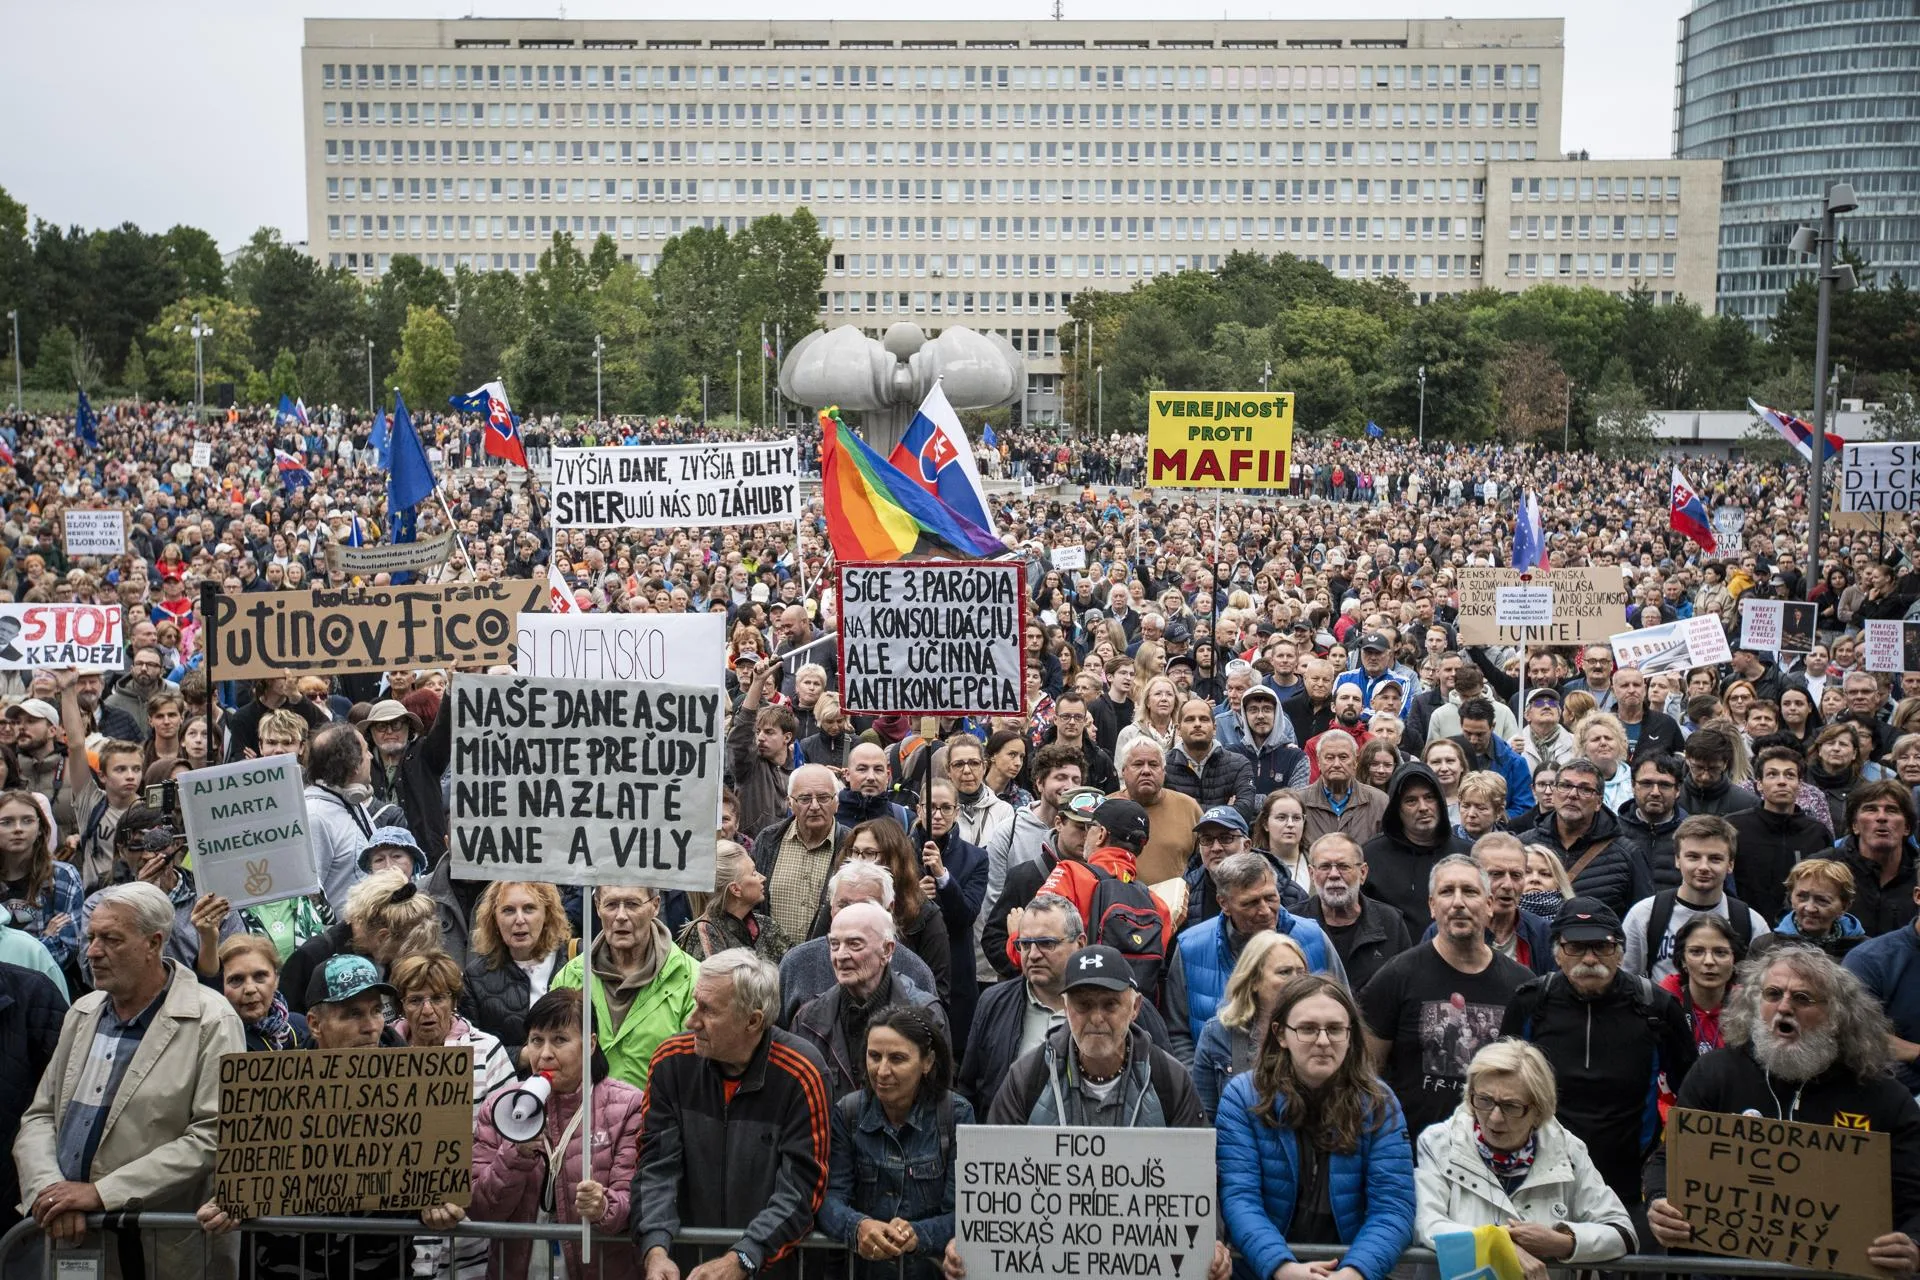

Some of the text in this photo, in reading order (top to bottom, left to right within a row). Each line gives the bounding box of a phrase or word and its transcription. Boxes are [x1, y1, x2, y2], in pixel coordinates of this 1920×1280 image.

[1156, 398, 1288, 421] VEREJNOSŤ
[1188, 426, 1252, 441] PROTI
[554, 447, 797, 485] ZVÝŠIA DANE, ZVÝŠIA DLHY,
[1152, 448, 1286, 482] MAFII
[660, 488, 691, 518] NÁS
[697, 494, 716, 516] DO
[719, 479, 795, 518] ZÁHUBY
[68, 538, 120, 546] SLOBODA!
[1535, 571, 1586, 580] SLOVENSKA
[23, 607, 121, 646] STOP
[844, 605, 1018, 647] NA KONSOLIDÁCIU,
[846, 639, 998, 676] ALE ÚČINNÁ
[458, 678, 719, 738] NAŠE DANE A SILY
[846, 676, 1019, 712] ANTIKONCEPCIA
[456, 729, 717, 779] MÍŇAJTE PRE ĽUDÍ
[194, 766, 285, 796] AJ JA SOM
[456, 780, 508, 818] NIE
[518, 778, 564, 818] NA
[210, 796, 278, 820] MARTA
[197, 820, 304, 856] ŠIMEČKOVÁ
[456, 826, 692, 871] VANE A VILY
[220, 1052, 468, 1084] OPOZICIA JE SLOVENSKO
[222, 1081, 472, 1115] DEMOKRATI, SAS A KDH.
[218, 1112, 422, 1144] MOŽNO SLOVENSKO
[1678, 1110, 1870, 1155] KOLABORANT
[216, 1140, 461, 1174] ZOBERIE DO VLADY AJ PS
[1055, 1134, 1106, 1158] FICO
[1709, 1142, 1802, 1174] FICO
[216, 1177, 246, 1204] ALE
[251, 1176, 274, 1201] TO
[280, 1174, 300, 1198] SA
[400, 1168, 472, 1196] ŠIMEČKA
[964, 1156, 1166, 1188] STRAŠNE SA BOJÍŠ
[255, 1201, 270, 1218] TO
[960, 1190, 1022, 1215] TOHO
[1030, 1186, 1062, 1216] ČO
[1126, 1194, 1142, 1218] A
[1144, 1194, 1211, 1218] PRETO
[1684, 1178, 1840, 1222] PUTINOV
[960, 1215, 1054, 1244] VRIESKAŠ
[1062, 1222, 1102, 1246] AKO
[1112, 1216, 1178, 1247] PAVIÁN
[1682, 1204, 1830, 1244] TRÓJSKÝ
[990, 1244, 1044, 1274] TAKÁ
[1052, 1251, 1081, 1275] JE
[1087, 1253, 1162, 1276] PRAVDA
